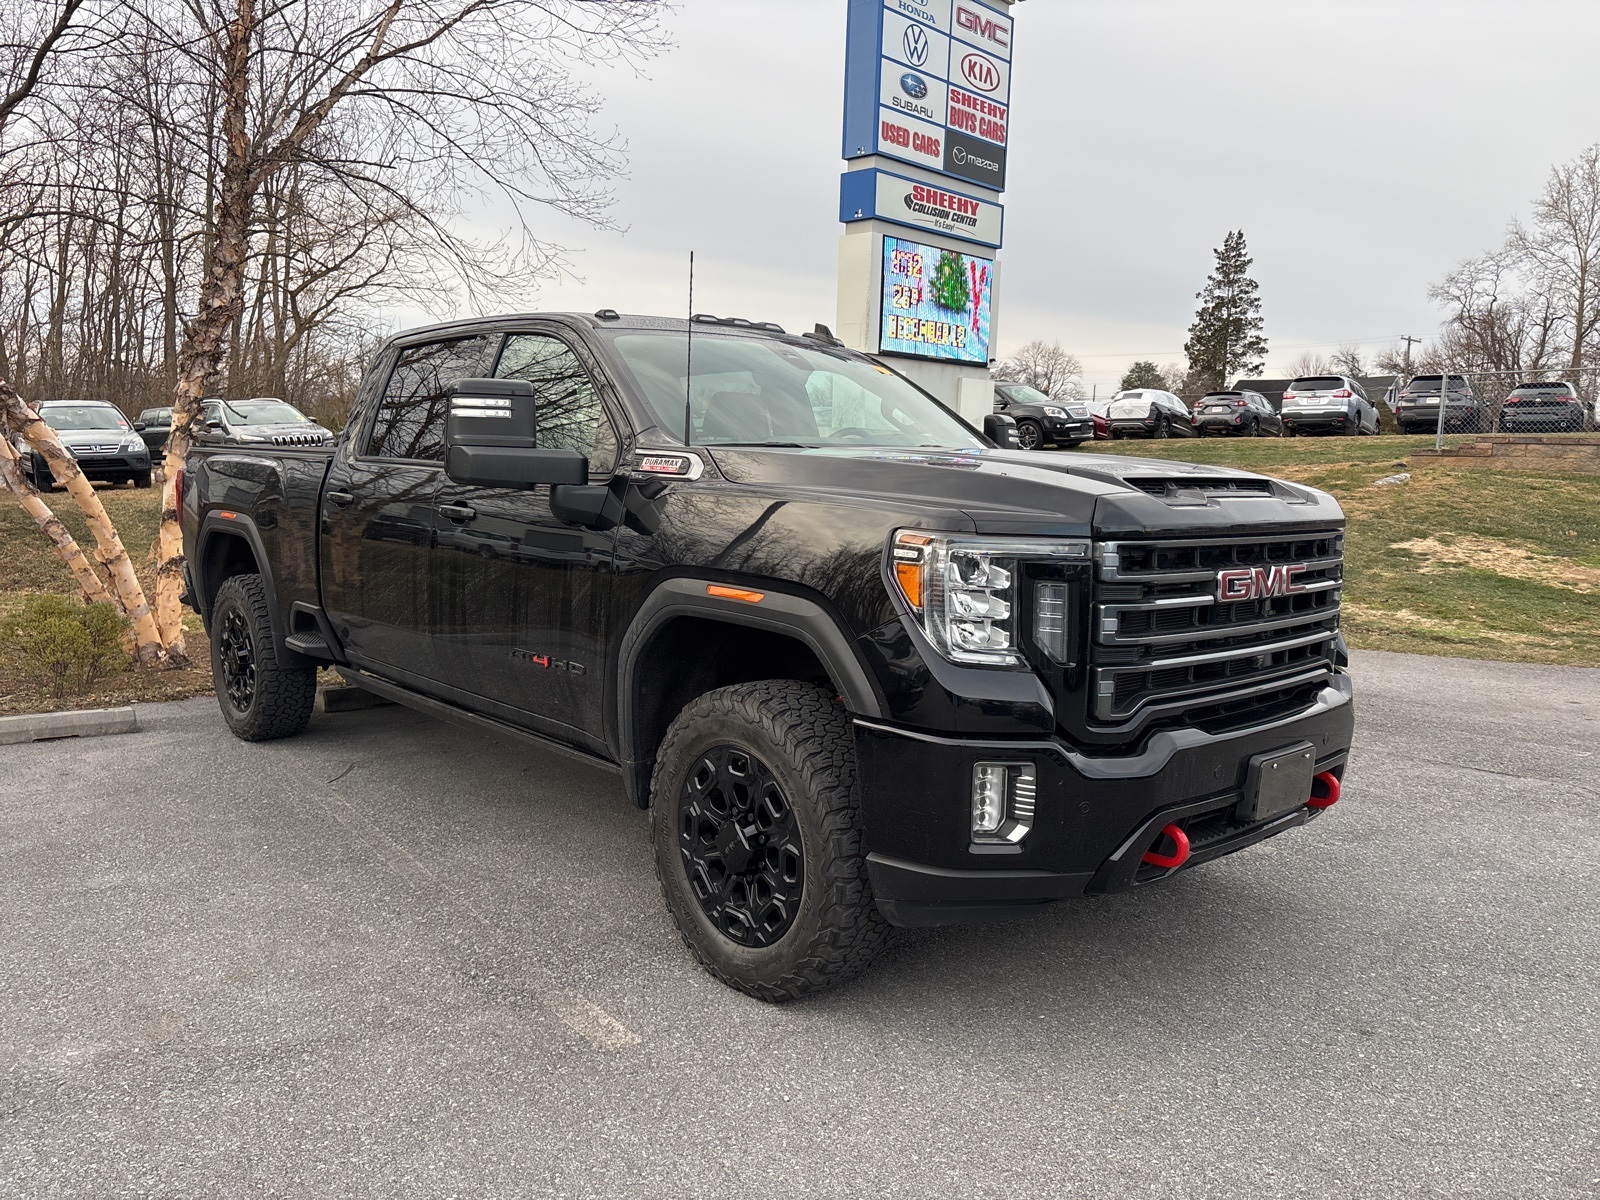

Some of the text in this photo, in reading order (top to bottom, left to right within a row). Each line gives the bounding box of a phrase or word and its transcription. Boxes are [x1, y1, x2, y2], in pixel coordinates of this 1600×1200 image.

[898, 3, 936, 24] HONDA
[956, 5, 1009, 48] GMC
[968, 59, 993, 87] KIA
[892, 96, 933, 119] SUBARU
[950, 89, 1007, 121] SHEEHY
[881, 121, 940, 158] USED CARS
[950, 105, 1005, 144] BUYS CARS
[967, 154, 999, 172] mazda
[912, 185, 980, 217] SHEEHY
[912, 202, 978, 228] COLLISION CENTER
[888, 314, 966, 348] DECEMBER 12
[644, 458, 680, 467] DURAMAX
[1217, 565, 1306, 602] GMC
